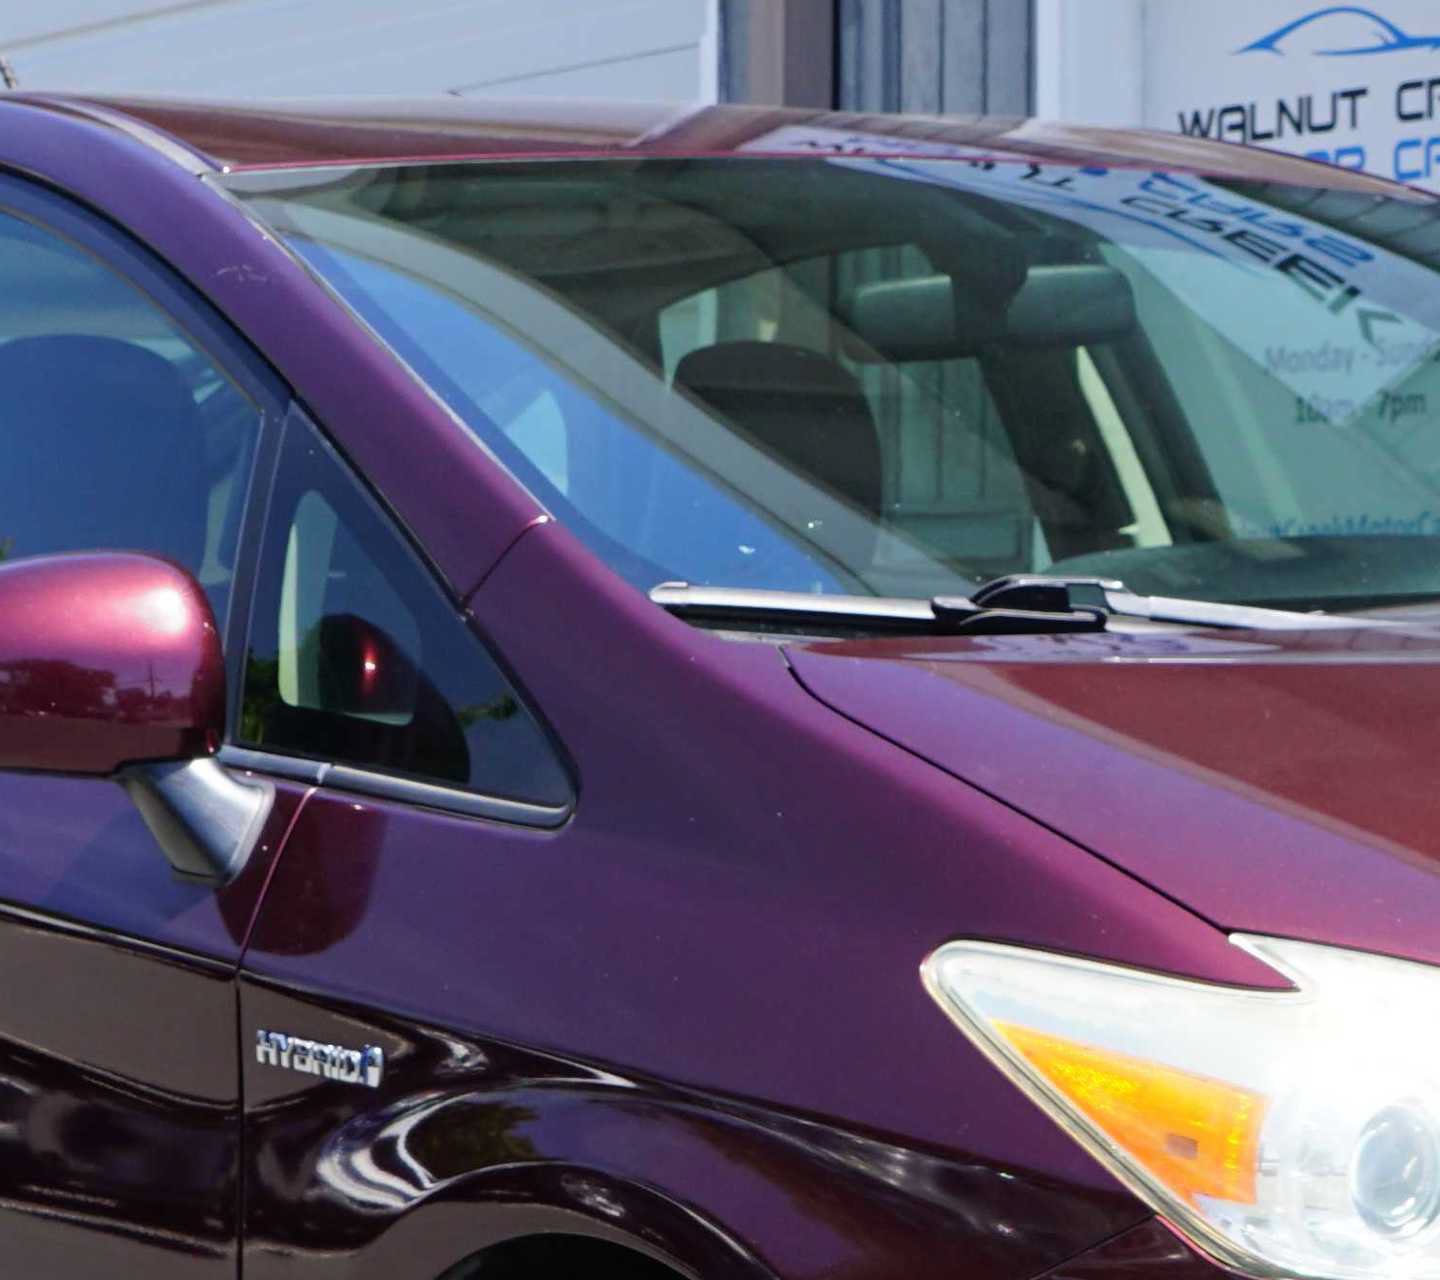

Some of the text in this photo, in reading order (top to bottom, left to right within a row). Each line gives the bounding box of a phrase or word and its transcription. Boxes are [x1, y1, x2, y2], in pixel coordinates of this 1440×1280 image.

[1177, 88, 1368, 145] WALNUT
[1376, 388, 1427, 426] 7pm
[255, 1028, 363, 1085] HYBRID
